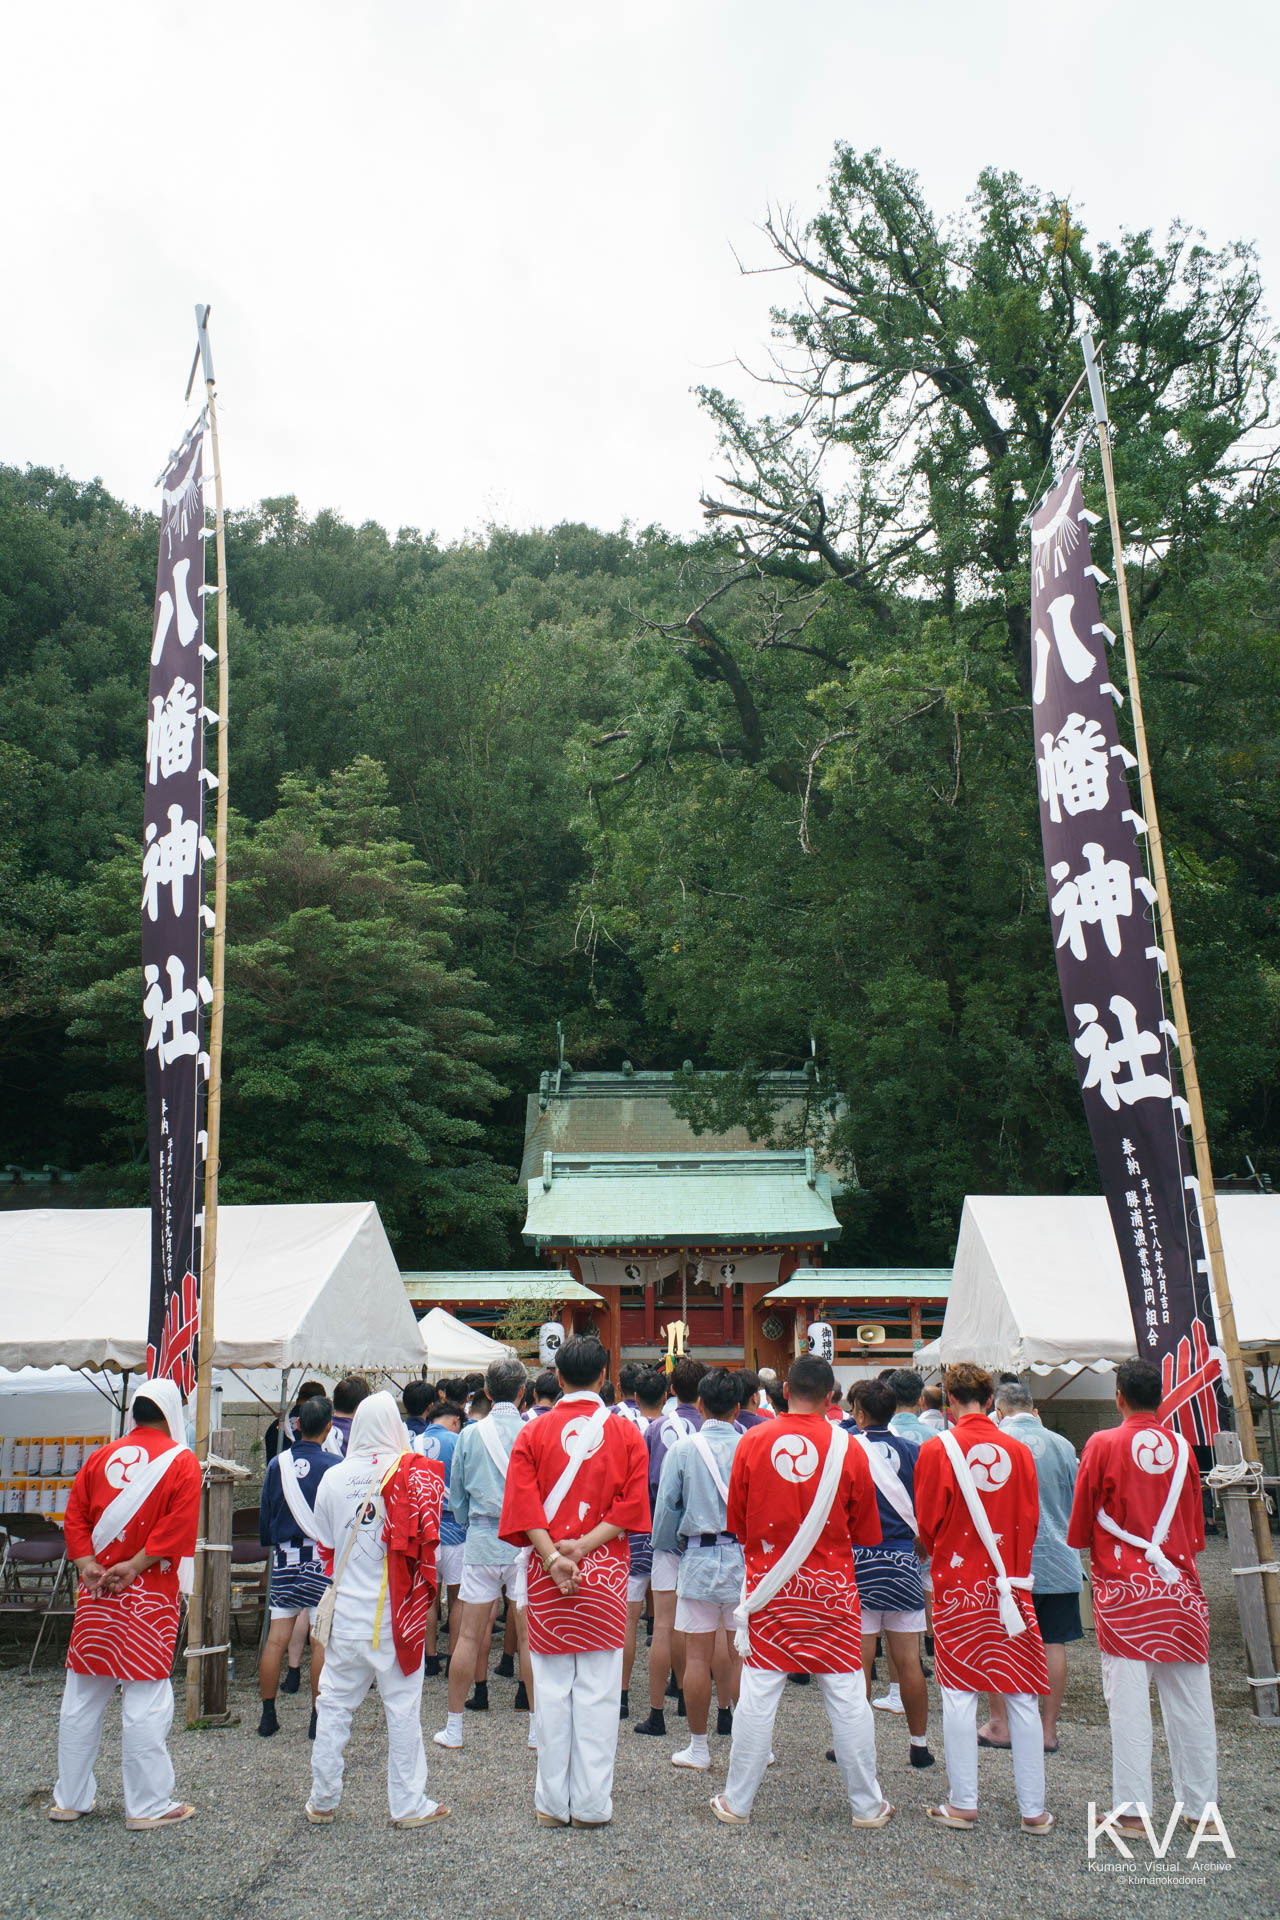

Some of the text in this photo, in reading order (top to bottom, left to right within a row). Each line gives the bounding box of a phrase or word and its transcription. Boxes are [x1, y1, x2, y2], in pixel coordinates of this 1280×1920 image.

[142, 558, 200, 1071] 八幡神社
[1033, 593, 1171, 1111] 八幡神社
[1121, 1137, 1160, 1347] 奉納 勝浦漁業協同組合
[1141, 1178, 1170, 1324] 平成二十八年九月吉日
